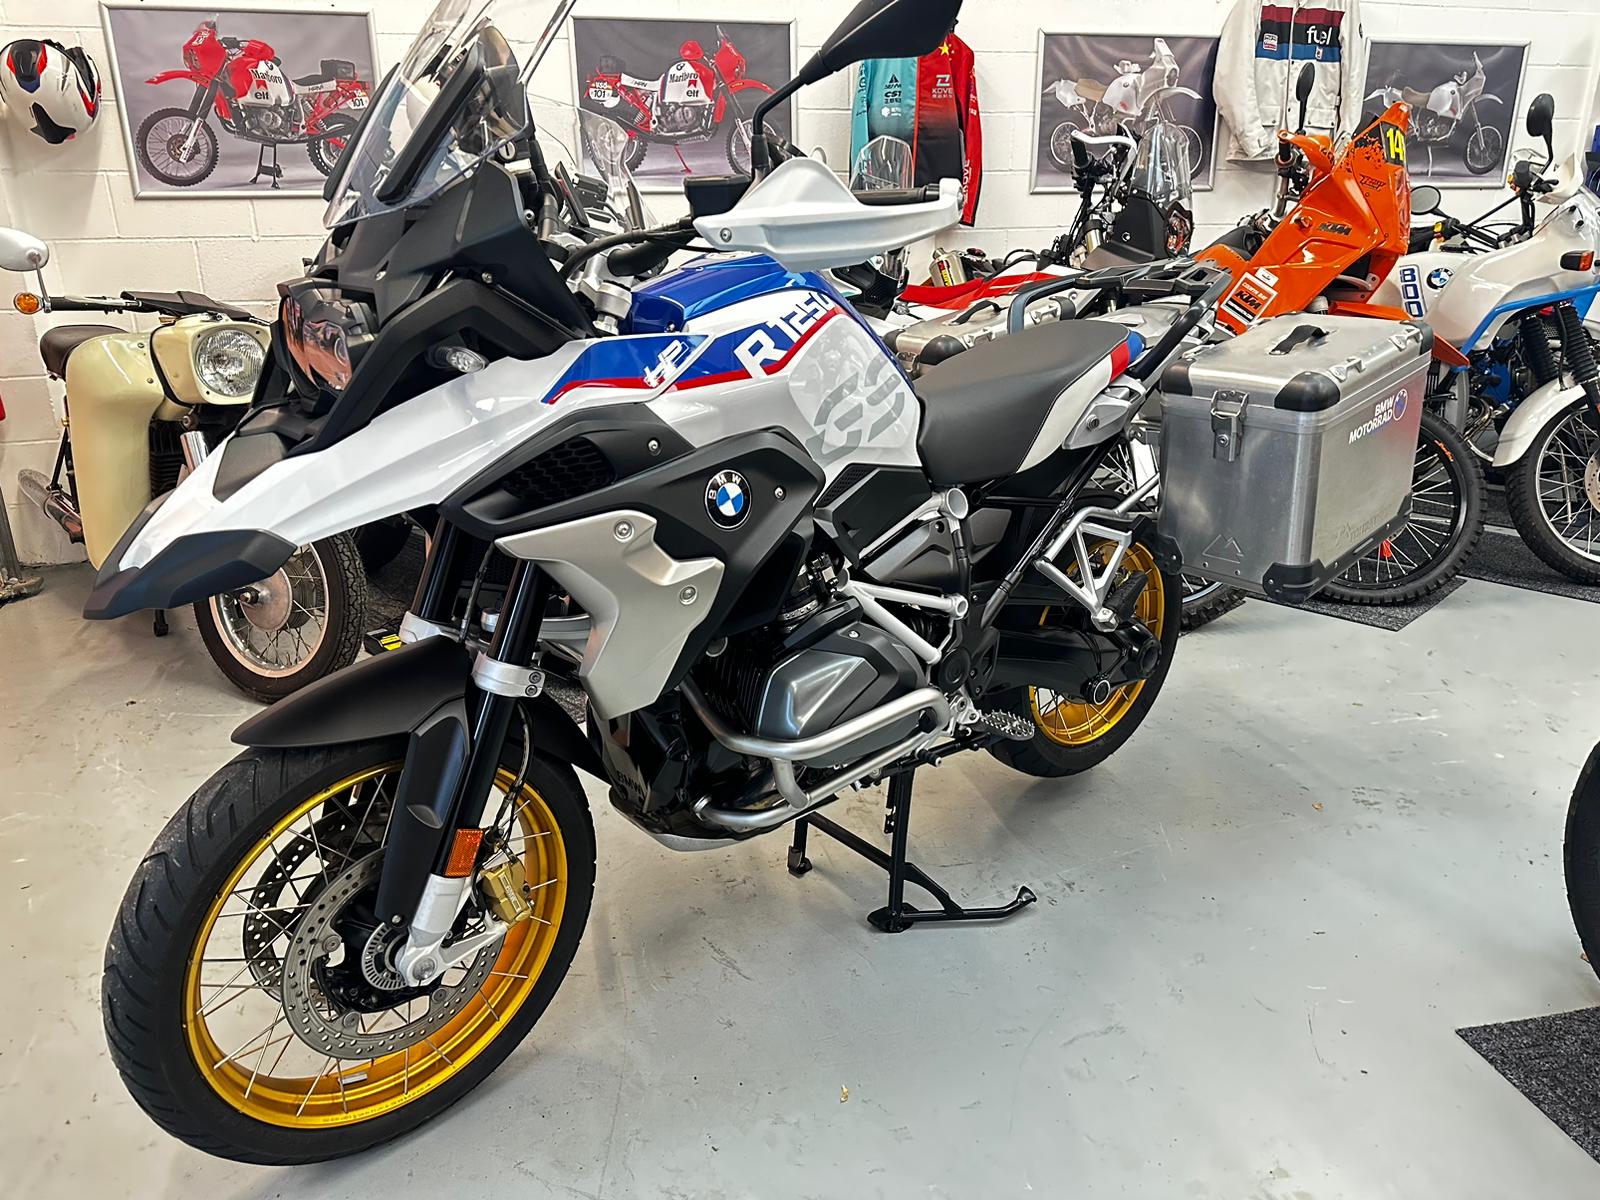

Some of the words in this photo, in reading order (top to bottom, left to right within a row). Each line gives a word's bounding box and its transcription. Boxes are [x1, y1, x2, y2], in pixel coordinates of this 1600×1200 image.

[1306, 25, 1333, 45] fuel
[251, 69, 283, 84] Marlboro
[669, 71, 699, 83] Marlboro
[254, 90, 269, 100] elf
[594, 89, 606, 98] 101
[686, 89, 700, 98] elf
[884, 90, 902, 98] CST
[352, 98, 365, 107] 101
[1235, 290, 1262, 311] KTM
[1399, 267, 1424, 318] 800
[733, 328, 789, 379] R
[1374, 394, 1395, 418] BMW
[1348, 408, 1393, 445] MOTORRAD
[708, 473, 742, 500] BMW
